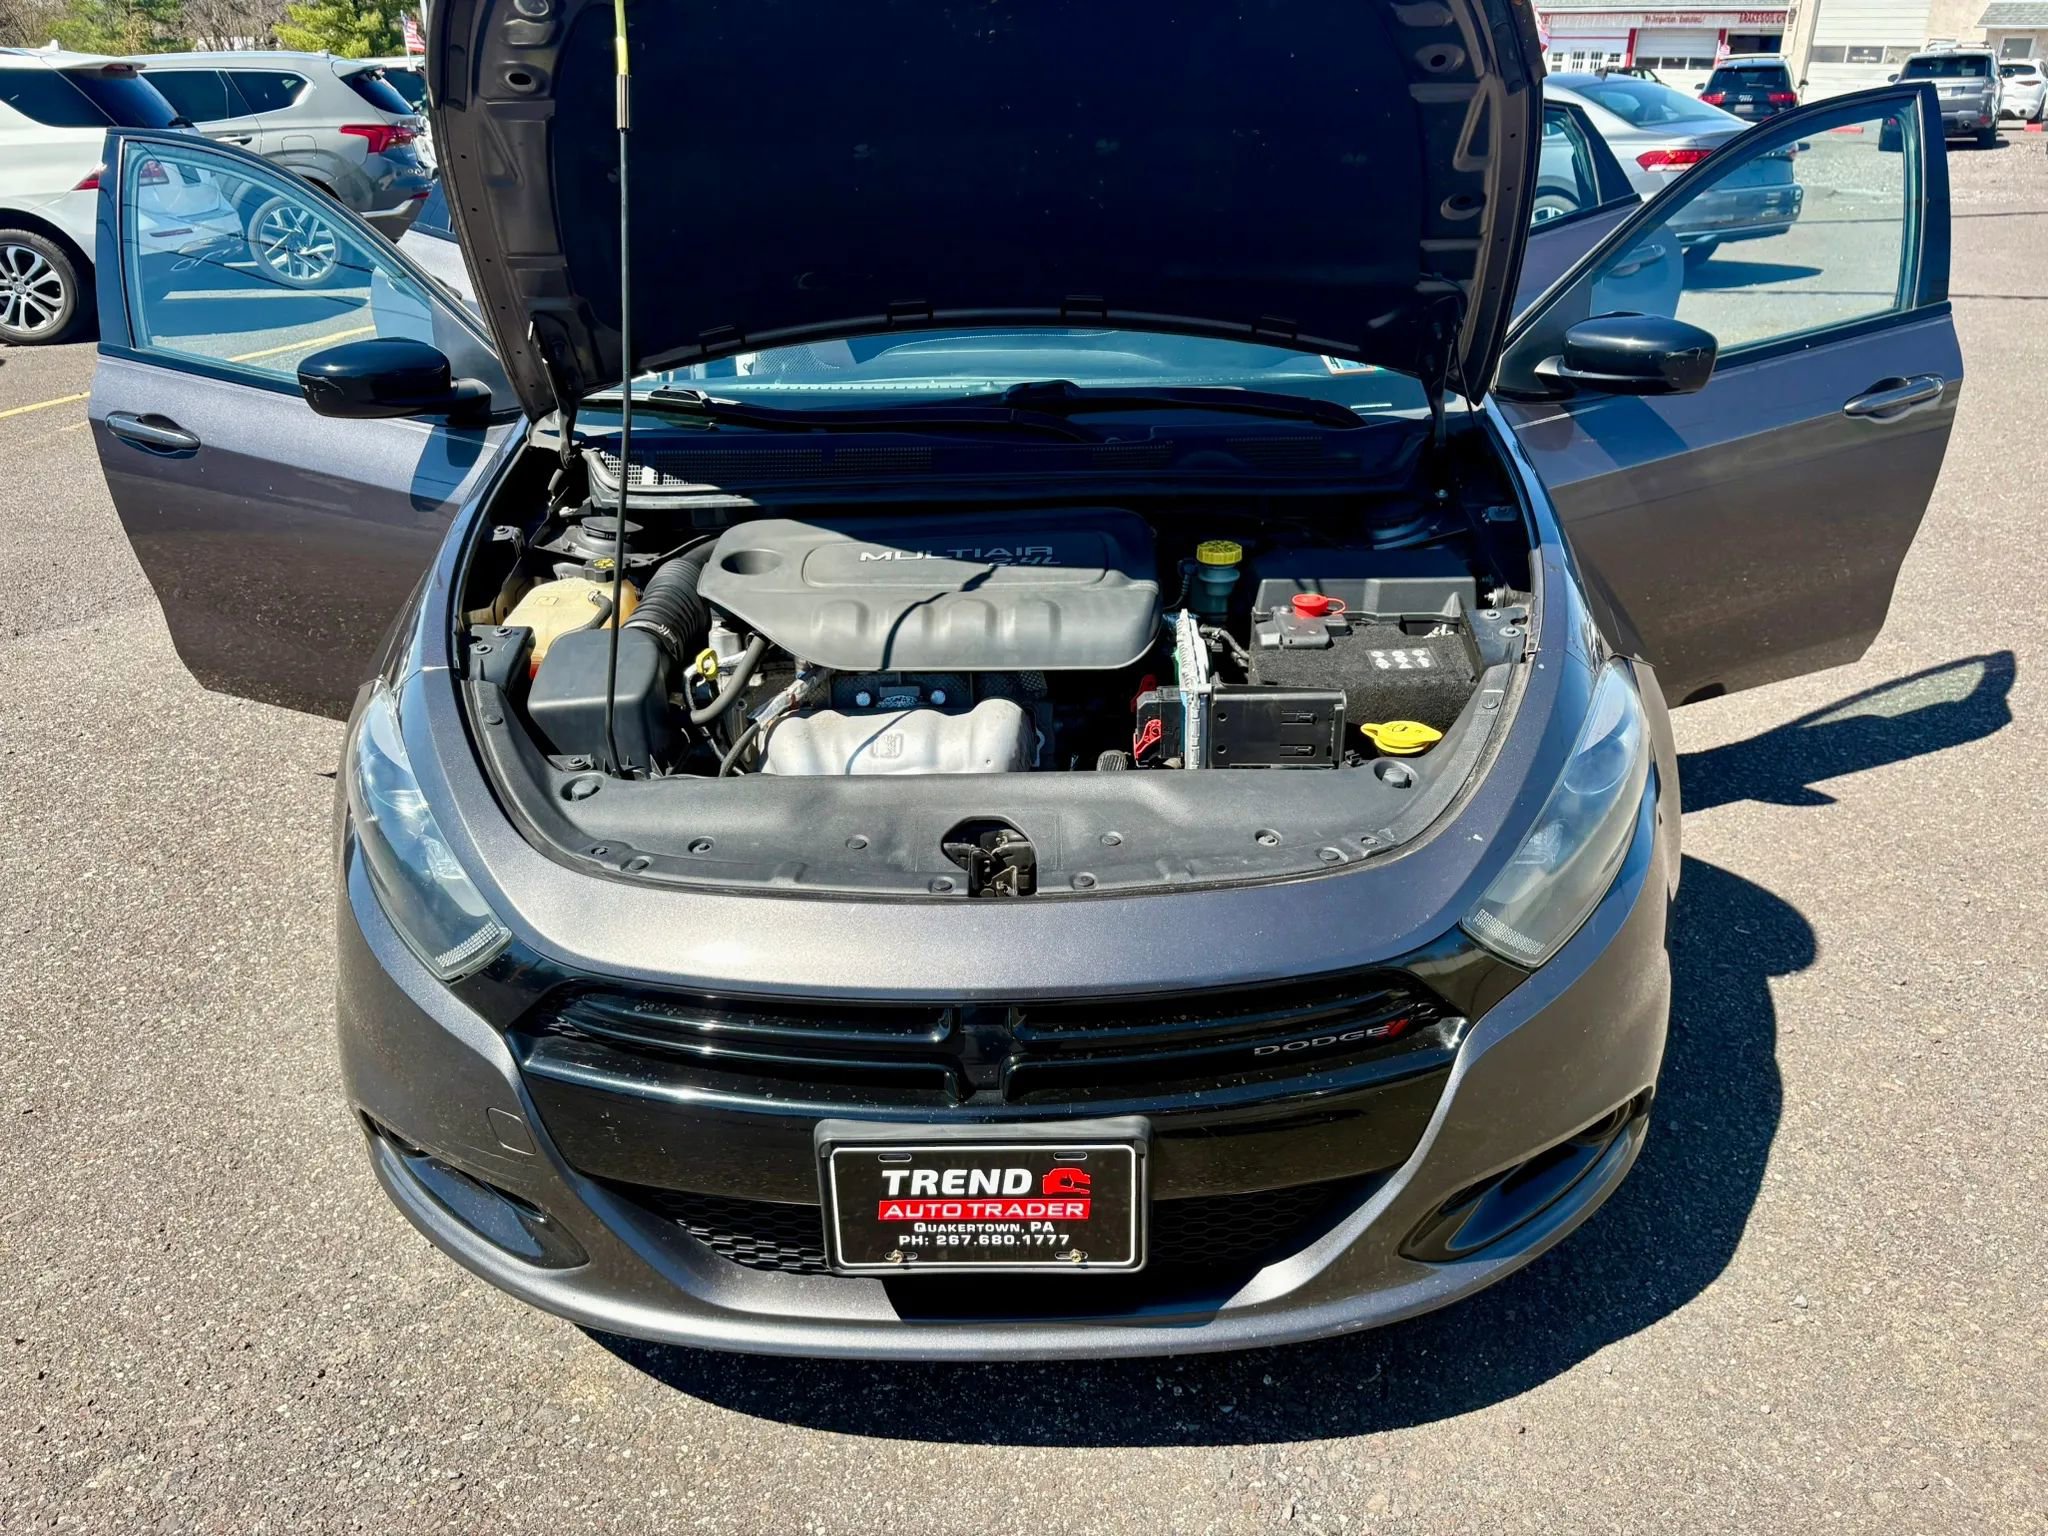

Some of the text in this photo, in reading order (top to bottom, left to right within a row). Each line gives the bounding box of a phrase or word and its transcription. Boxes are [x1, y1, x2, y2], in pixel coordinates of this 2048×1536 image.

[859, 546, 1053, 562] MULTIAIR
[988, 556, 1061, 568] 2.4L
[1254, 1025, 1390, 1056] DODGE
[881, 1168, 1033, 1196] TREND
[884, 1202, 1084, 1218] AUTO TRADER
[1030, 1221, 1055, 1232] PA
[899, 1234, 1070, 1246] PH: 267.680.1777
